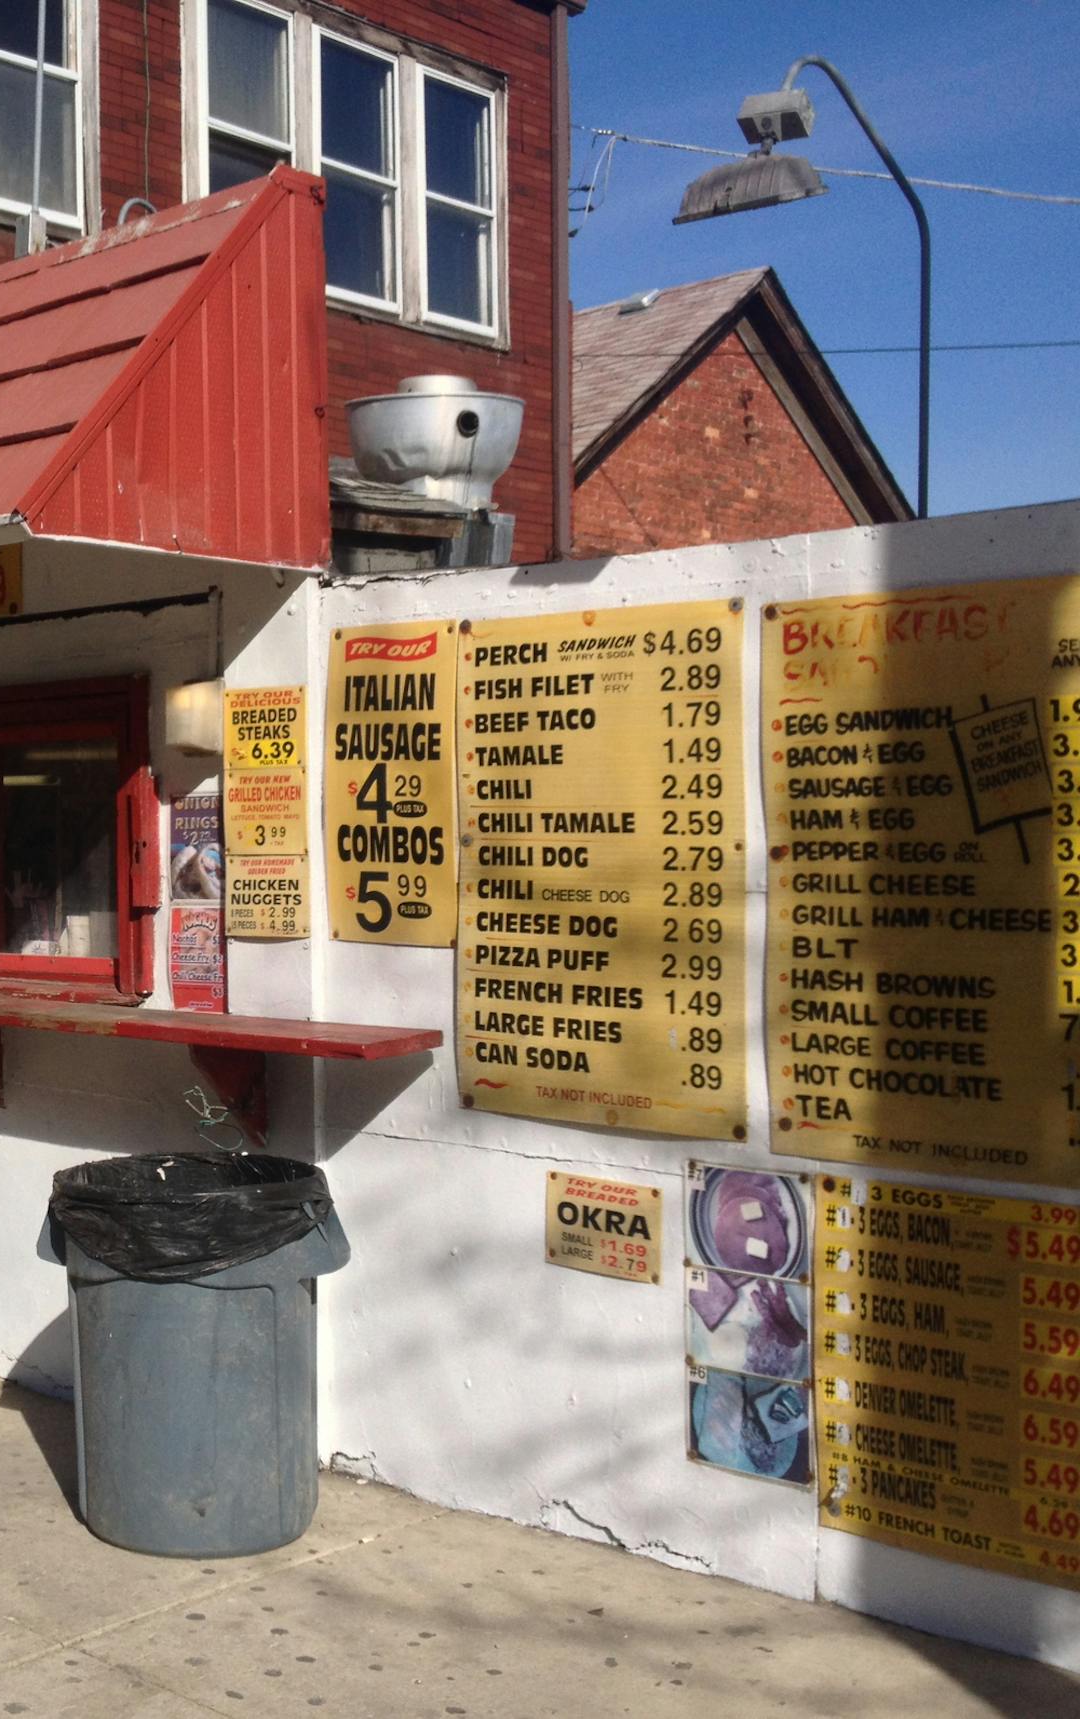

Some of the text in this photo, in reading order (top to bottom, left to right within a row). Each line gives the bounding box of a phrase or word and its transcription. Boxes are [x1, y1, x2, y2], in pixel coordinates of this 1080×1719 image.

[349, 636, 432, 657] TRY OUR
[474, 626, 722, 667] PERCH SANDWICH $4.69
[344, 672, 436, 713] ITALIAN
[474, 664, 722, 700] FISH FILET WITH 2.89
[603, 683, 630, 694] FRY
[230, 697, 302, 708] DELICIOUS
[233, 689, 293, 700] TRY OUR
[231, 708, 297, 725] BREADED
[474, 700, 722, 734] BEEF TACO 1.79
[785, 705, 953, 736] EGG SANDWICH
[237, 725, 291, 742] STEAKS
[335, 722, 442, 763] SAUSAGE
[251, 742, 295, 760] 6.39
[474, 737, 722, 767] TAMALE 1.49
[786, 741, 926, 768] BACON EGG
[228, 785, 302, 802] GRILLED CHICKEN
[240, 803, 290, 813] SANDWICH
[396, 804, 426, 815] PLUS TAX
[790, 808, 915, 831] HAM EGG
[175, 816, 218, 829] RINGS
[477, 810, 724, 836] CHILI TAMALE 2.59
[337, 824, 444, 866] COMBOS
[233, 879, 299, 892] CHICKEN
[477, 878, 722, 908] CHILI CHEESE DOG 2.89
[792, 873, 976, 896] GRILL CHEESE
[230, 894, 302, 906] NUGGETS
[476, 911, 618, 938] CHEESE DOG
[792, 937, 858, 959] BLT
[475, 944, 722, 981] PIZZA PUFF 2.99
[790, 969, 996, 1000] HASH BROWNS
[474, 978, 722, 1017] FRENCH FRIES 1.49
[791, 1000, 988, 1033] SMALL COFFEE
[475, 1042, 722, 1090] CAN SODA .89
[793, 1063, 1003, 1102] HOT CHOCOLATE
[535, 1086, 652, 1110] TAX NOT INCLUDED
[795, 1094, 852, 1121] TEA
[565, 1188, 639, 1207] BREADED
[891, 1188, 943, 1209] EGGS
[557, 1201, 652, 1241] OKRA
[561, 1231, 593, 1247] SMALL
[561, 1246, 593, 1261] LARGE
[692, 1272, 706, 1283] #1
[689, 1367, 706, 1379] #6
[871, 1472, 936, 1511] PANCAKES
[878, 1512, 935, 1538] FRENCH
[943, 1527, 992, 1550] TOAST
